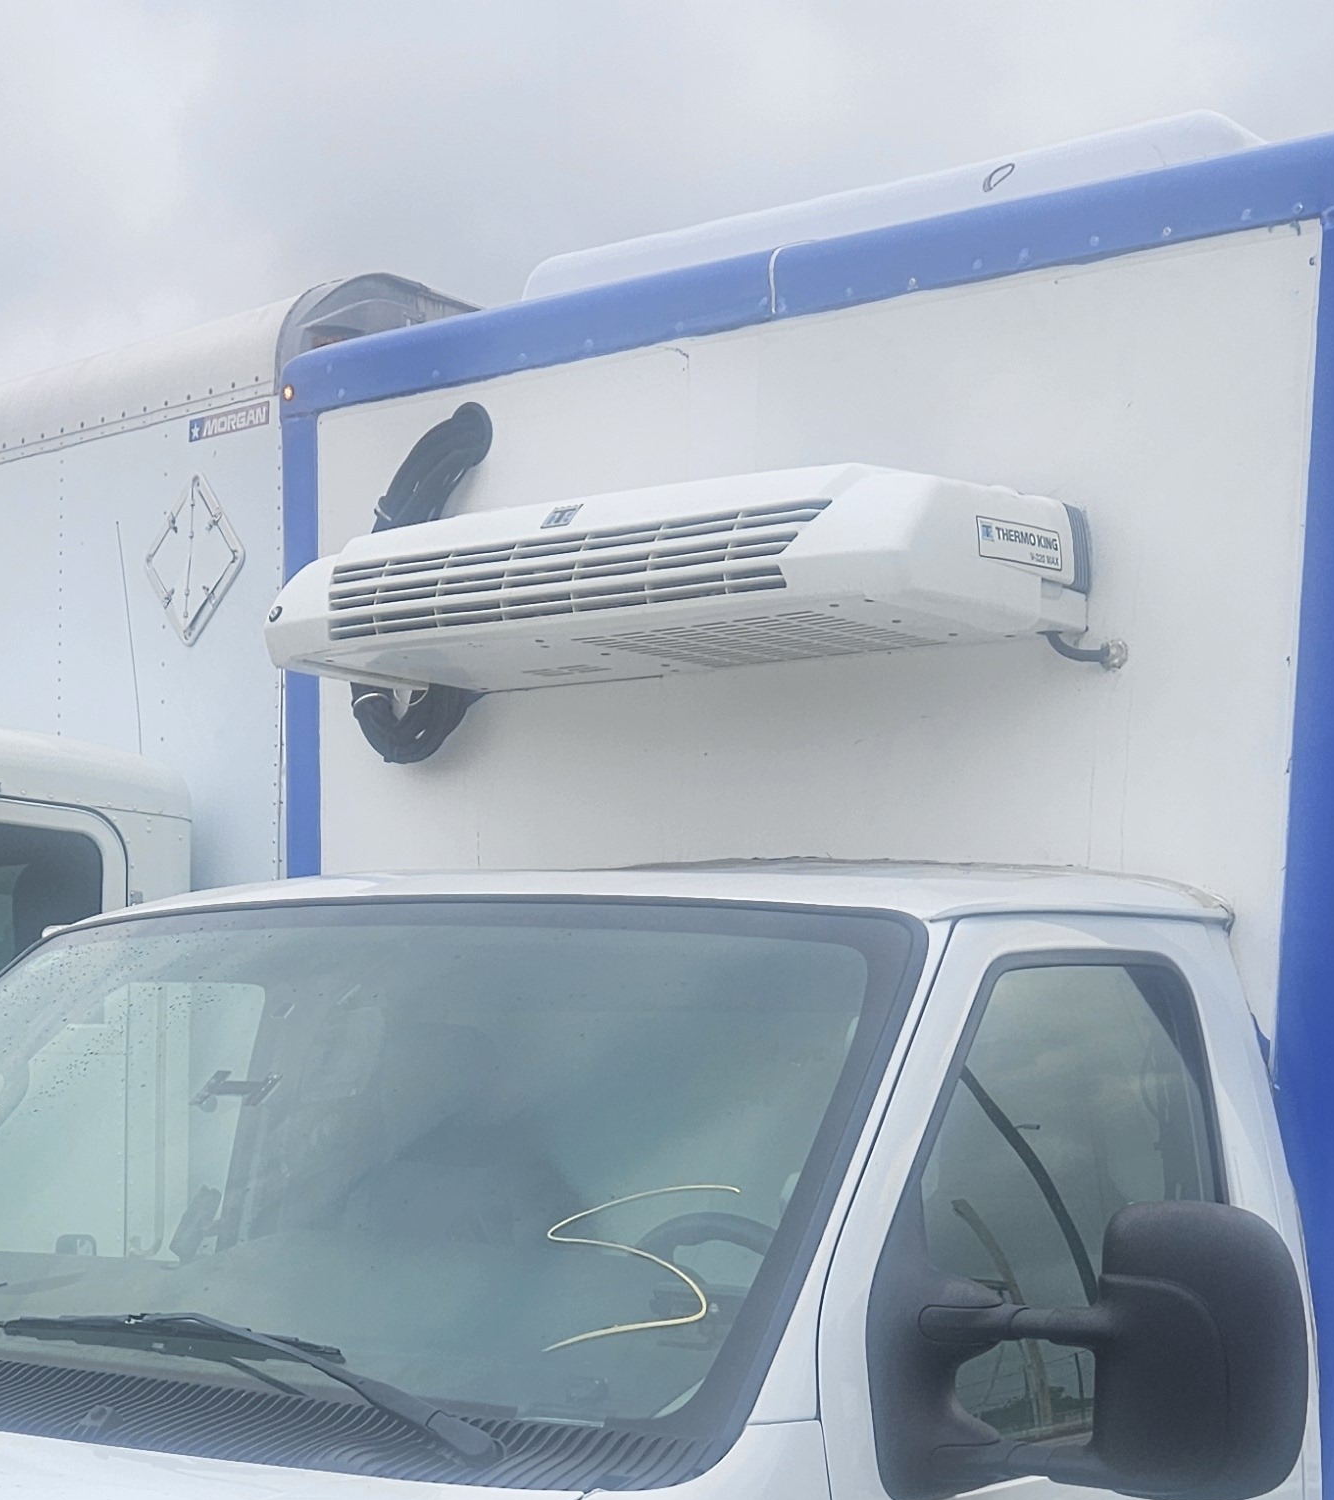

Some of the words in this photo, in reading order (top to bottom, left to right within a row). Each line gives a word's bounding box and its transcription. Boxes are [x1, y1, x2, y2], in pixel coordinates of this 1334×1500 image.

[203, 406, 267, 437] MORGAN
[995, 527, 1036, 546] THERMO
[1038, 535, 1058, 551] KING
